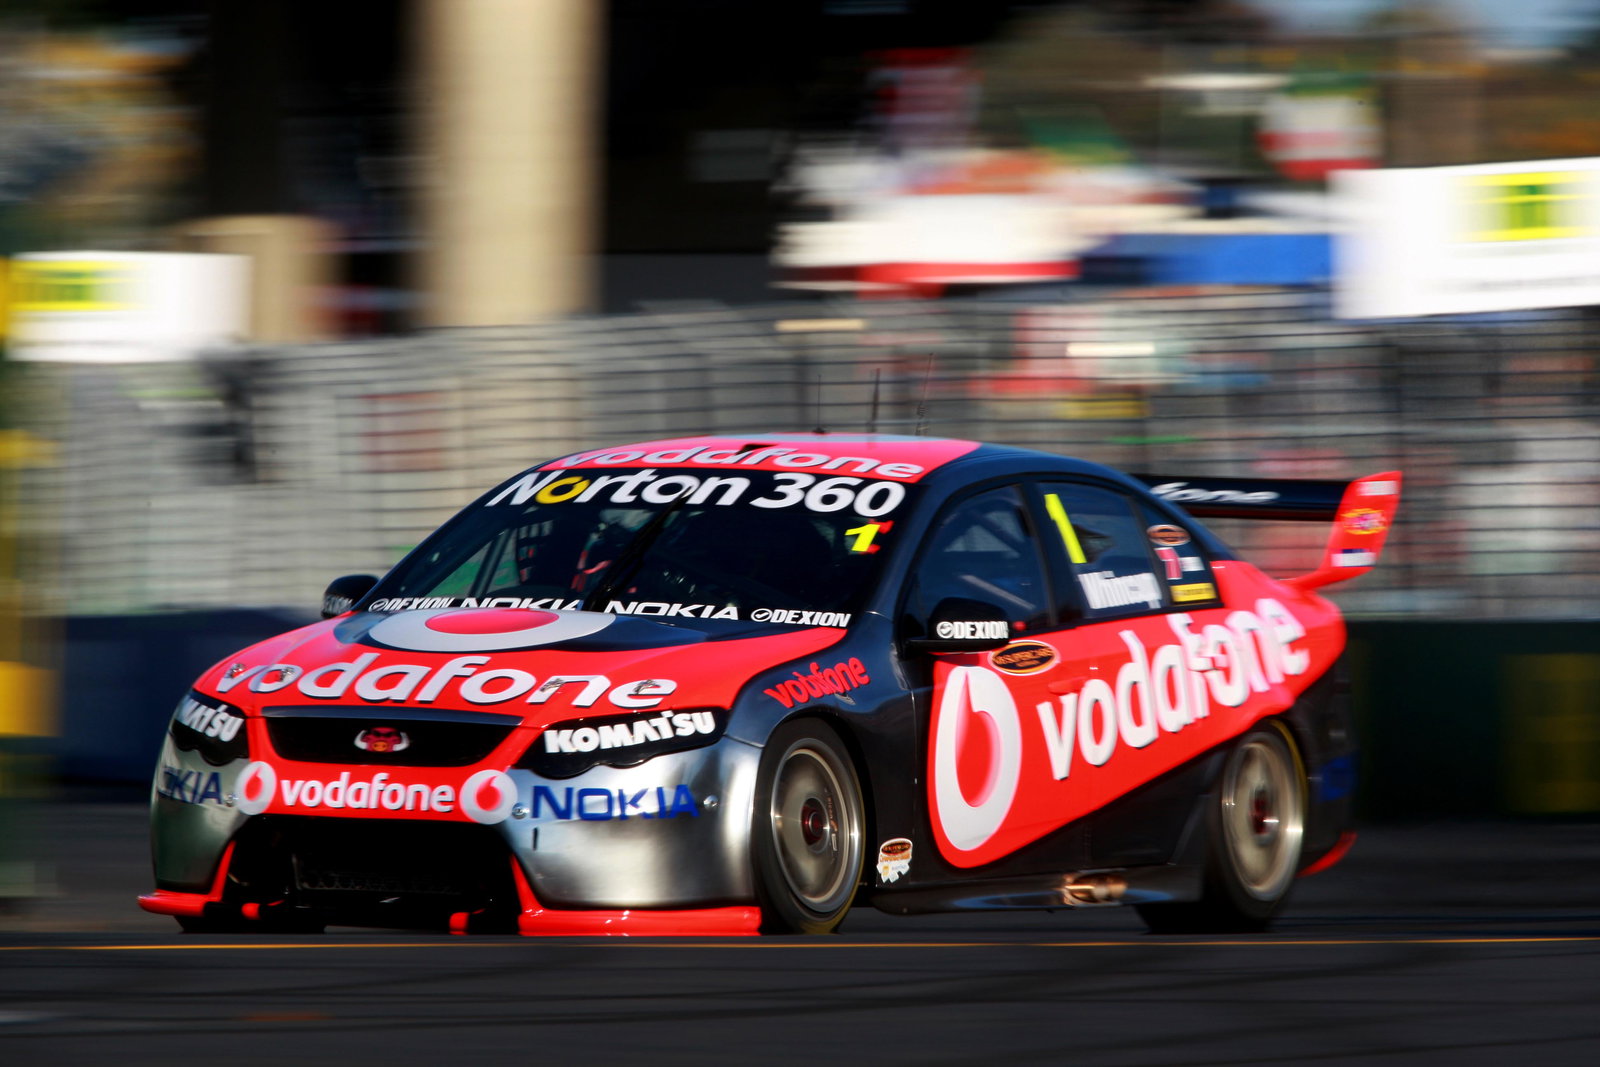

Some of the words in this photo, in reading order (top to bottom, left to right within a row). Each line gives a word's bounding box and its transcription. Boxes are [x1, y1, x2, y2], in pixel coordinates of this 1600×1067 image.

[560, 445, 925, 478] vodafone
[484, 469, 750, 505] Norton
[750, 472, 906, 517] 360
[1045, 494, 1087, 563] 1
[604, 600, 739, 620] NOKIA
[770, 608, 852, 628] DEXION
[953, 621, 1009, 639] DEXION
[216, 652, 678, 709] vodafone
[1037, 600, 1311, 782] vodafone
[544, 711, 716, 754] KOMATSU
[281, 772, 455, 813] vodafone
[531, 784, 700, 821] NOKIA
